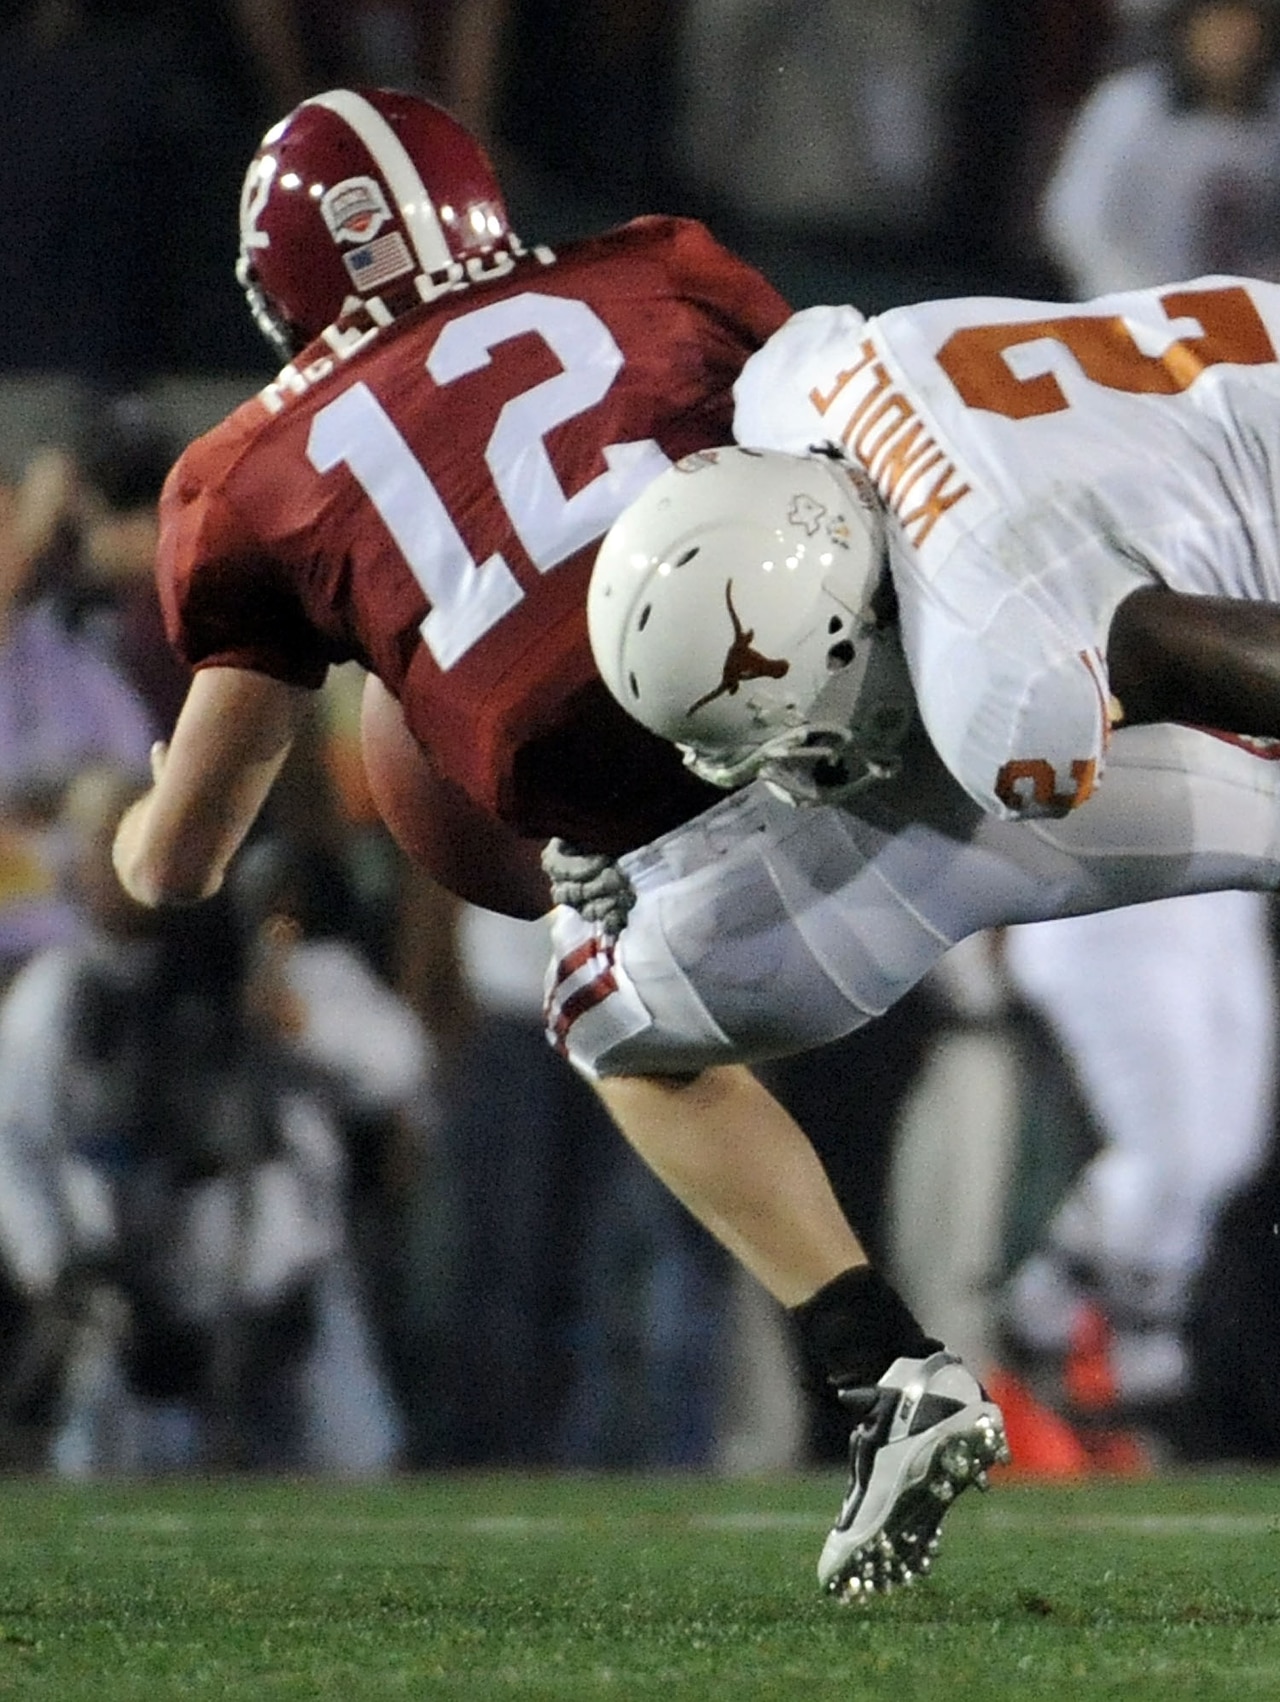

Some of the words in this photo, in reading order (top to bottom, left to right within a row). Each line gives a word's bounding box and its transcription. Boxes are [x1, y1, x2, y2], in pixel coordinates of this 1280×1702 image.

[935, 286, 1278, 420] 2
[306, 292, 676, 672] 12
[808, 338, 971, 550] KINDLE
[994, 758, 1096, 822] 2
